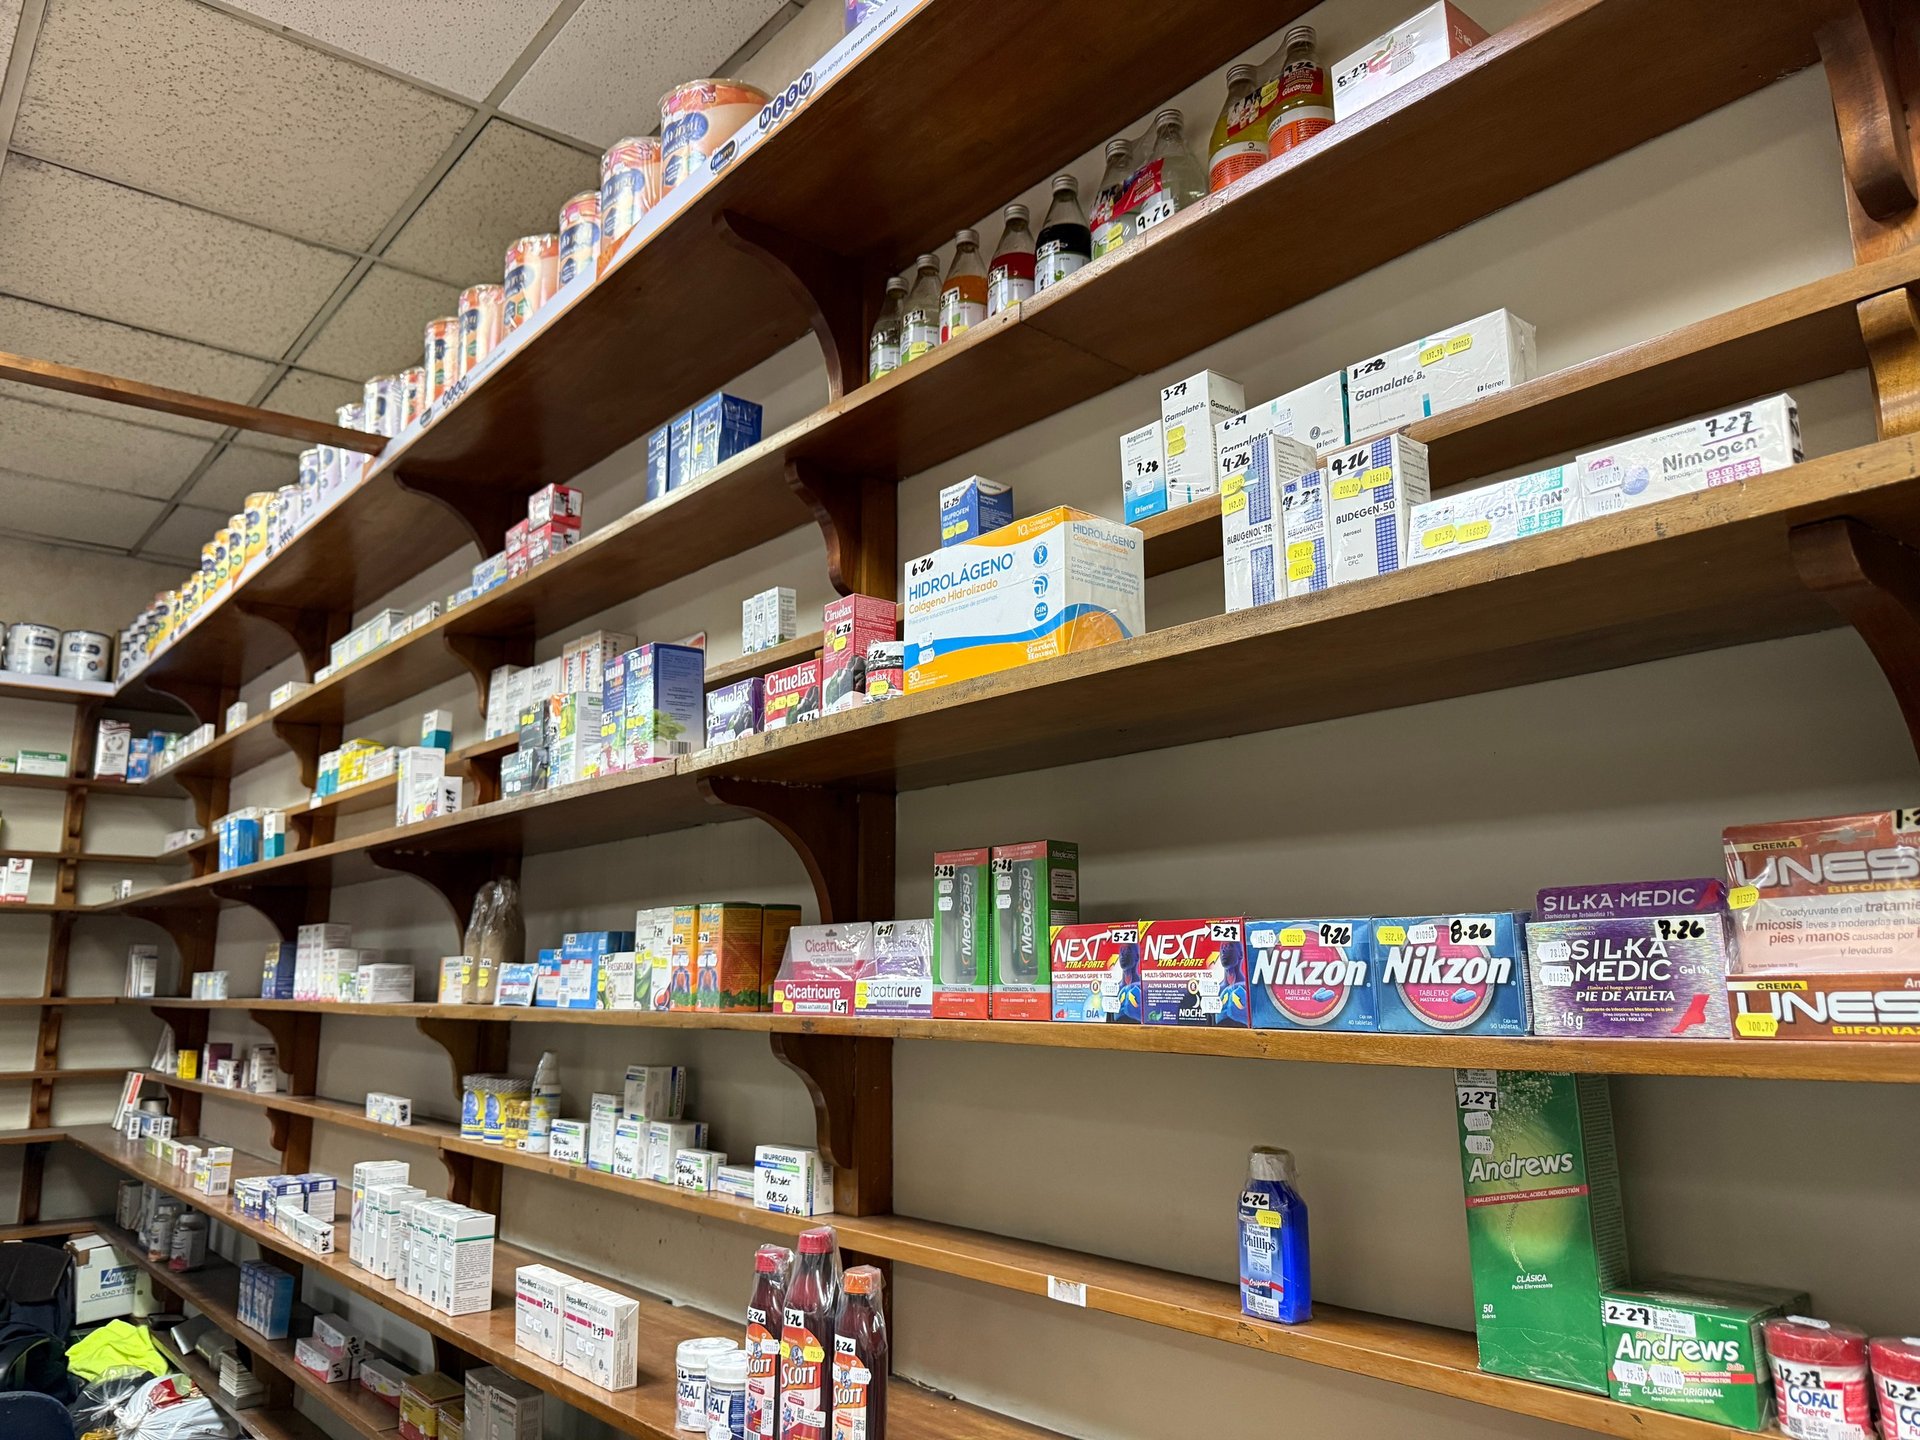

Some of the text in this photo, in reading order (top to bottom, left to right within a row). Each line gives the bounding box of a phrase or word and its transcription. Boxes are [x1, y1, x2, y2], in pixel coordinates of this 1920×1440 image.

[851, 25, 878, 52] desarrollo
[878, 5, 899, 27] mental
[1353, 358, 1386, 379] 1-28
[1163, 382, 1188, 401] 3-27
[1355, 373, 1414, 402] Gamalate
[1484, 379, 1505, 391] ferrer
[1322, 436, 1339, 449] ferrer
[1223, 451, 1250, 472] 4-26
[1332, 449, 1369, 476] 9-26
[1662, 436, 1757, 474] Nimogen
[1336, 500, 1396, 525] BUDEGEN-50
[1073, 523, 1136, 550] HIDROLÁGENO
[1343, 528, 1362, 538] Aerosol
[909, 553, 1013, 602] HIDROLÁGENO
[909, 578, 999, 616] Colágeno Hidrolizado
[825, 603, 852, 622] Ciruelax
[1036, 605, 1047, 614] SIN
[766, 666, 816, 696] Ciruelax
[908, 670, 921, 683] 30
[1752, 840, 1797, 851] CREMA
[1543, 887, 1696, 912] SILKA-MEDIC
[961, 872, 972, 956] Medicasp
[1020, 867, 1033, 954] Medicasp
[1780, 905, 1839, 918] Coadyuvante
[1854, 905, 1863, 913] el
[1213, 925, 1238, 940] 5-27
[1755, 918, 1802, 931] micosis
[1805, 920, 1828, 930] leves
[1892, 917, 1906, 926] en
[1113, 930, 1137, 942] 5-27
[1769, 931, 1794, 947] pies
[1805, 931, 1850, 943] manos
[1852, 931, 1895, 941] causadas
[1897, 930, 1914, 942] por
[1054, 937, 1103, 962] NEXT
[1143, 934, 1198, 961] NEXT
[1847, 945, 1893, 957] levaduras
[1065, 960, 1106, 969] XTRA-FORTE
[1157, 958, 1206, 967] XTRA-FORTE
[1251, 949, 1368, 986] Nikzon
[1382, 945, 1512, 985] Nikzon
[1575, 959, 1673, 982] MEDIC
[1679, 965, 1696, 975] Gel
[785, 983, 841, 1000] Cicatricure
[1418, 989, 1450, 997] TABLETAS
[1756, 982, 1802, 991] CREMA
[1576, 990, 1676, 1002] PIE DE ATLETA
[1086, 1008, 1099, 1018] DÍA
[1561, 1012, 1574, 1026] 15
[1747, 1019, 1774, 1032] 100.70
[763, 1152, 797, 1164] IBUPROFENO
[1468, 1151, 1574, 1184] Andrews
[1247, 1227, 1269, 1238] Magnesia
[1244, 1233, 1276, 1254] Phillips
[1249, 1278, 1271, 1288] Original
[1516, 1272, 1547, 1284] CLÁSICA
[1483, 1303, 1493, 1314] 50
[1607, 1305, 1651, 1325] 2-27
[1615, 1332, 1740, 1361] Andrews
[781, 1363, 816, 1388] SCOTT
[1778, 1363, 1822, 1389] 12-27
[832, 1385, 863, 1407] SCOTT
[1683, 1388, 1724, 1398] ORIGINAL
[1788, 1383, 1839, 1410] COFAL
[1796, 1405, 1832, 1419] Fuerte
